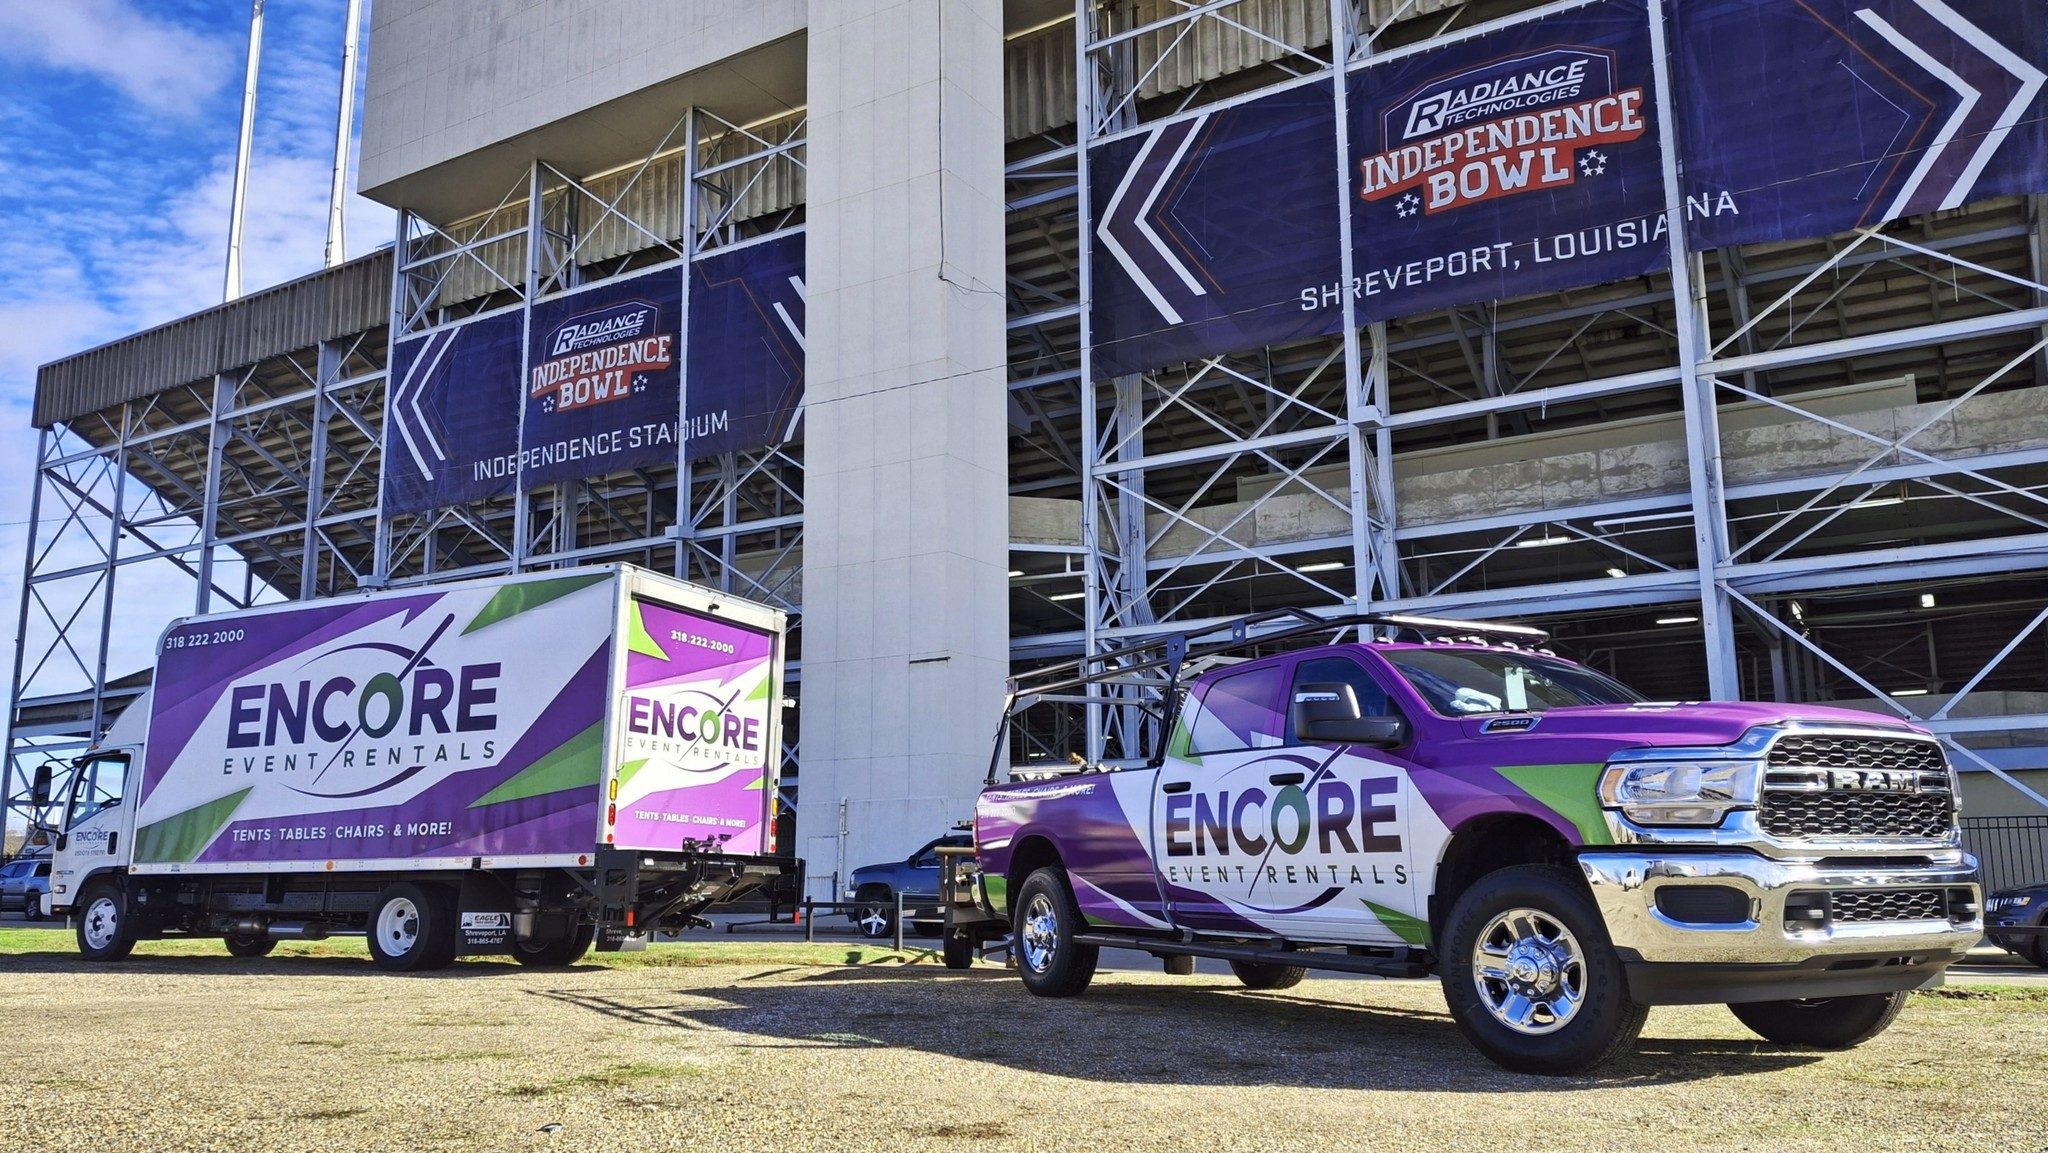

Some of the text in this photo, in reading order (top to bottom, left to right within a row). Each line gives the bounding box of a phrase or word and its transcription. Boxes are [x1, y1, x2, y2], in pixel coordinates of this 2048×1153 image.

[1403, 59, 1589, 140] RADIANCE
[1444, 84, 1582, 127] TECHNOLOGIES
[1362, 91, 1644, 195] INDEPENDENCE
[1428, 147, 1569, 211] BOWL
[1300, 242, 1520, 312] SHREVEPORT,
[551, 309, 648, 356] RADIANCE
[573, 327, 641, 350] TECHNOLOGIES
[531, 335, 671, 393] INDEPENDENCE
[558, 370, 628, 409] BOWL
[473, 430, 622, 481] INDEPENDENCE
[670, 630, 734, 654] 318.222.2000
[226, 662, 502, 749] ENCORE
[628, 696, 759, 752] ENCORE
[1492, 719, 1529, 727] 2500
[223, 741, 496, 775] EVENT RENTALS
[627, 737, 759, 765] EVENT RENTALS
[1834, 770, 1915, 791] RAM
[76, 831, 109, 841] ENCORE
[232, 822, 453, 842] TENTS TABLES CHAIRS & MORE!
[635, 811, 659, 820] TENTS
[662, 813, 689, 823] TABLES
[692, 815, 718, 825] CHAIRS
[726, 819, 746, 828] MORE!
[1166, 776, 1403, 857] ENCORE
[1169, 864, 1407, 885] EVENT RENTALS
